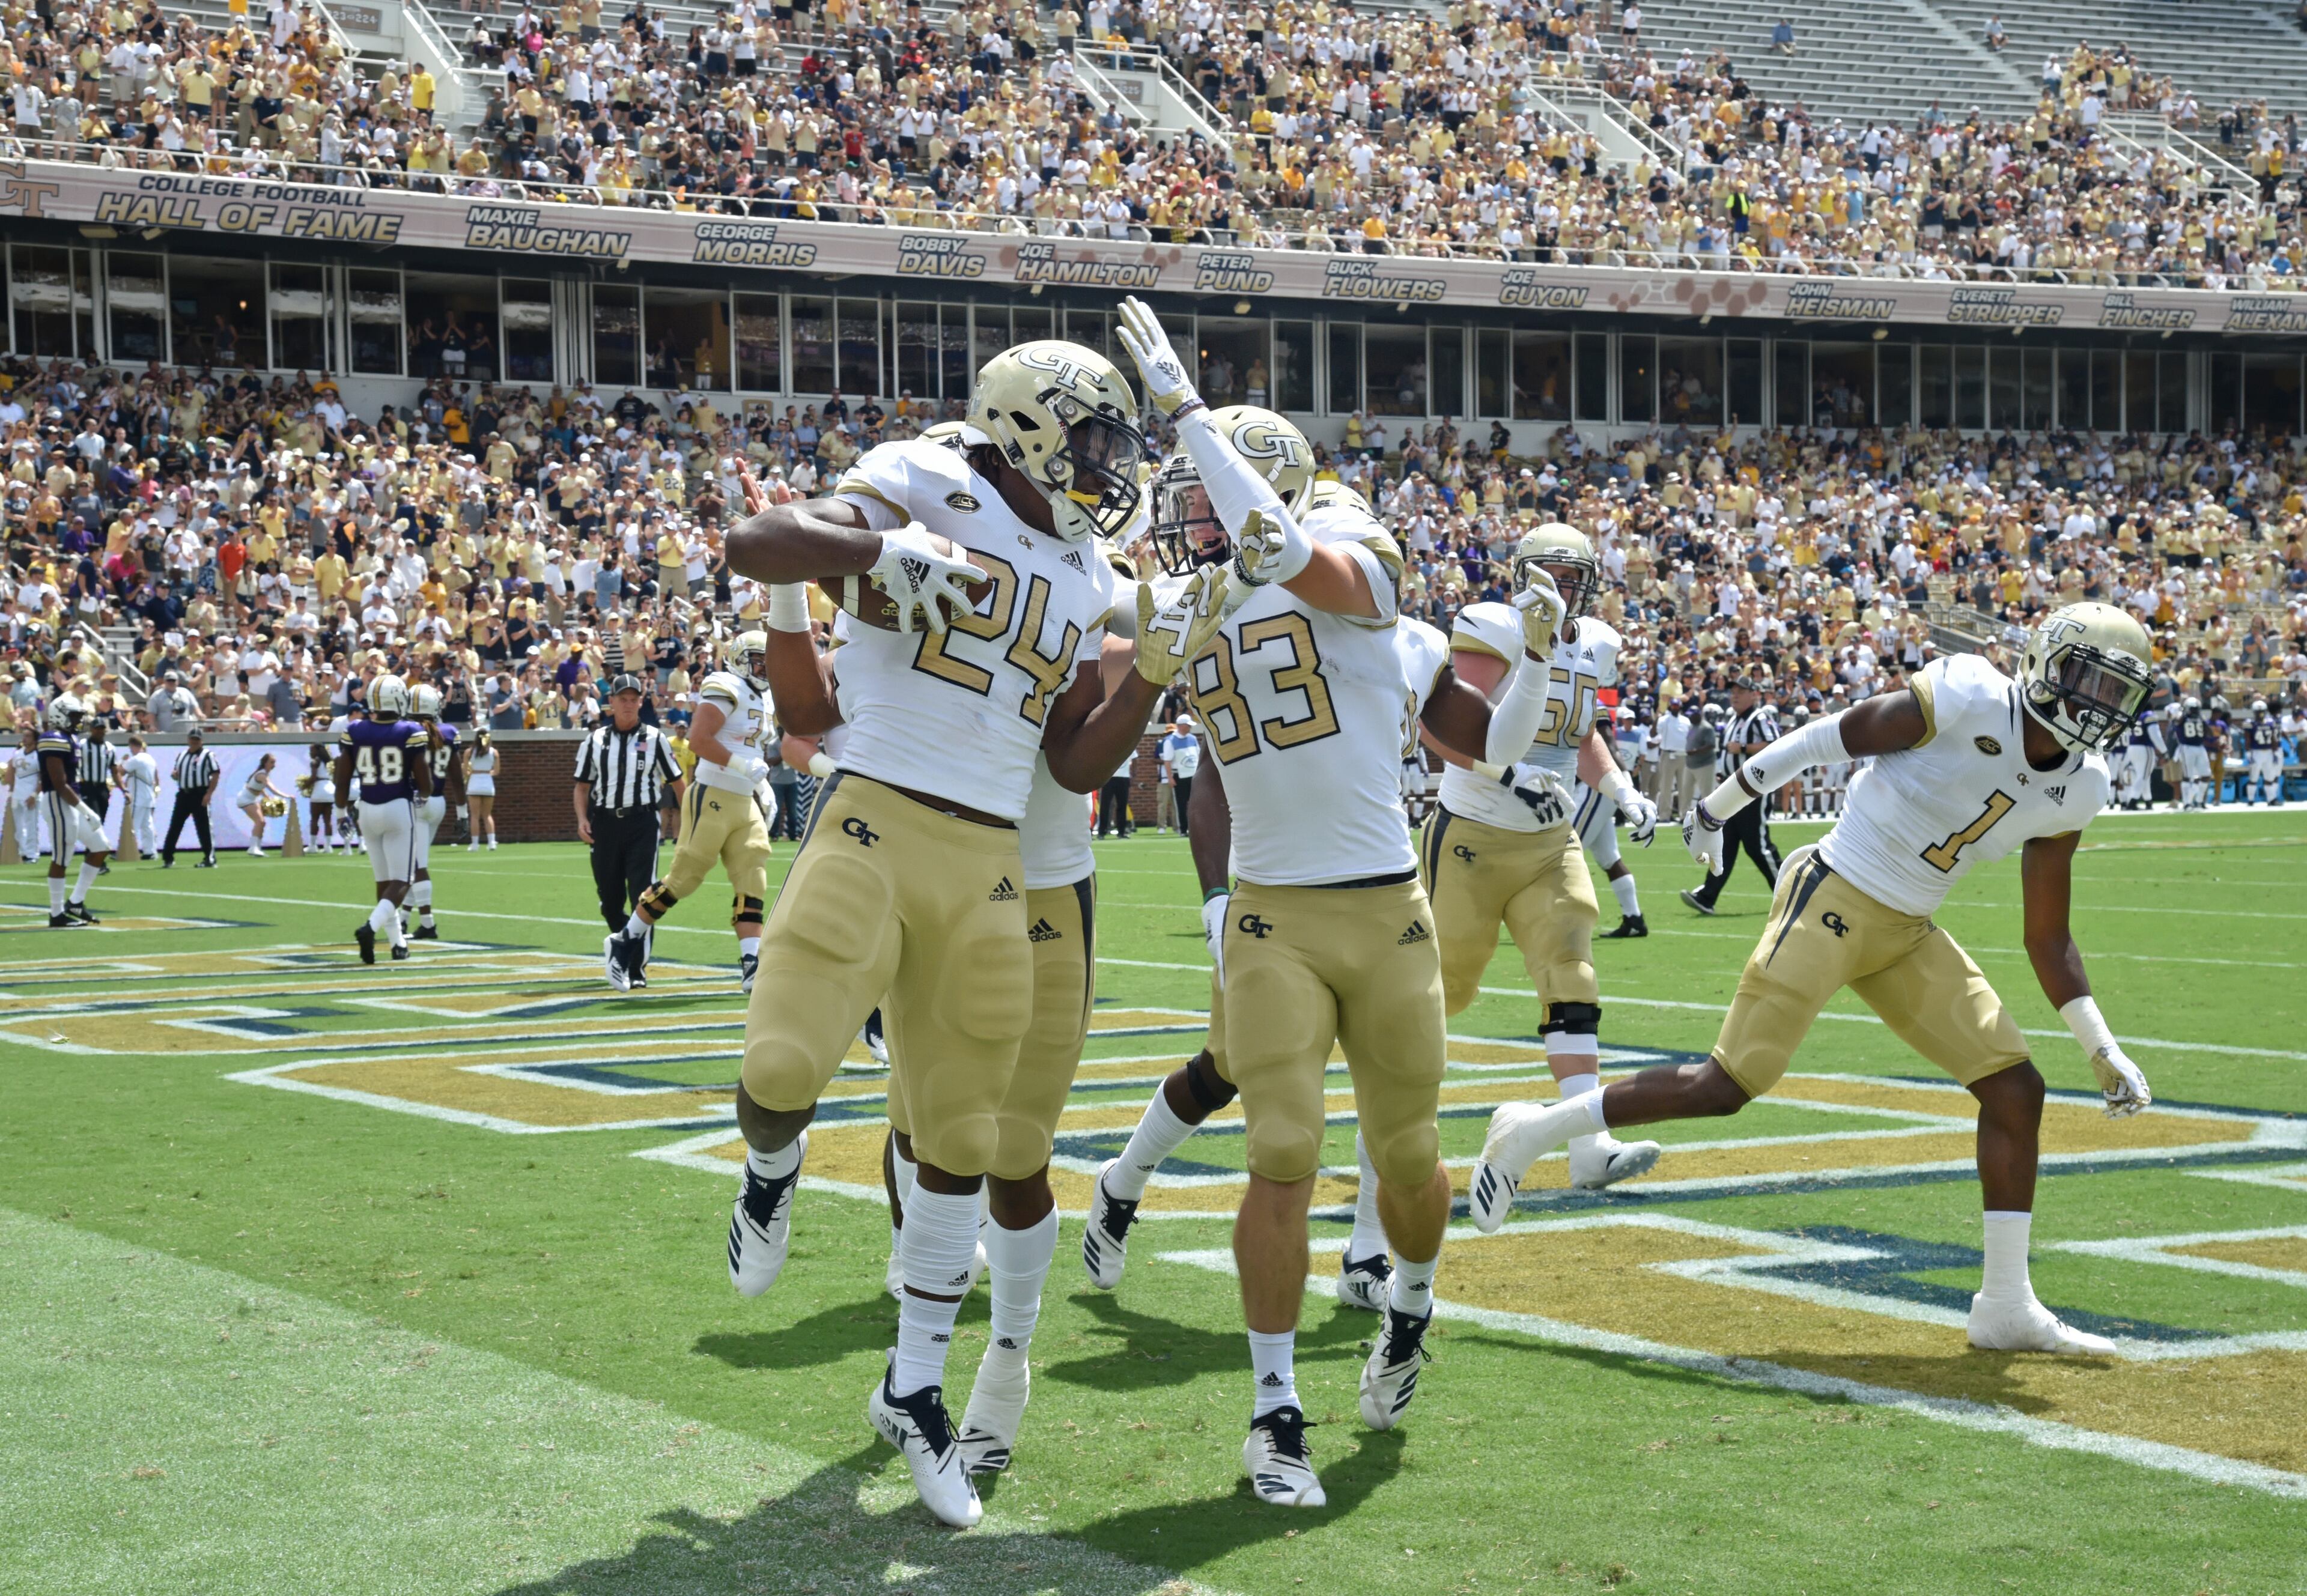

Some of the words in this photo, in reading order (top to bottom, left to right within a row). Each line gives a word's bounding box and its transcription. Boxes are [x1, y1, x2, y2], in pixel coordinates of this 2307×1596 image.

[139, 175, 243, 198] COLLEGE
[252, 184, 366, 207] FOOTBALL
[94, 192, 206, 228] HALL
[217, 202, 276, 232] OF
[282, 208, 404, 241] FAME
[466, 205, 540, 226] MAXIE
[465, 224, 632, 257] BAUGHAN
[695, 222, 777, 241] GEORGE
[693, 240, 816, 267] MORRIS
[900, 235, 967, 253] BOBBY
[1018, 243, 1055, 259] JOE
[898, 252, 985, 278] DAVIS
[1198, 253, 1253, 270] PETER
[1325, 261, 1377, 277] BUCK
[1015, 258, 1160, 288] HAMILTON
[1195, 269, 1273, 293] PUND
[1502, 270, 1534, 285] JOE
[1322, 276, 1446, 301] FLOWERS
[1500, 285, 1588, 308] GUYON
[1789, 282, 1833, 297] JOHN
[1951, 288, 2014, 303] EVERETT
[1785, 298, 1896, 320] HEISMAN
[2104, 294, 2134, 307] BILL
[2229, 298, 2291, 312] WILLIAM
[1948, 303, 2064, 324] STRUPPER
[2099, 308, 2195, 329] FINCHER
[1018, 347, 1103, 390] GT
[1232, 421, 1303, 467] GT
[1172, 457, 1187, 466] ACC
[664, 478, 679, 490] 22
[950, 496, 976, 507] ACC
[1018, 535, 1035, 550] GT
[901, 557, 920, 593] adidas
[1061, 556, 1087, 576] adidas
[911, 548, 1081, 729] 24
[2121, 657, 2139, 667] ACC
[1188, 610, 1341, 766] 83
[1979, 739, 2000, 752] ACC
[356, 745, 404, 786] 48
[637, 760, 645, 770] B
[2044, 788, 2063, 807] adidas
[842, 817, 880, 848] GT
[1919, 789, 2016, 873] 1
[1453, 845, 1476, 862] GT
[989, 891, 1019, 901] adidas
[1239, 914, 1273, 939] GT
[1822, 912, 1849, 938] GT
[1029, 930, 1062, 942] didas
[1398, 932, 1429, 945] adidas
